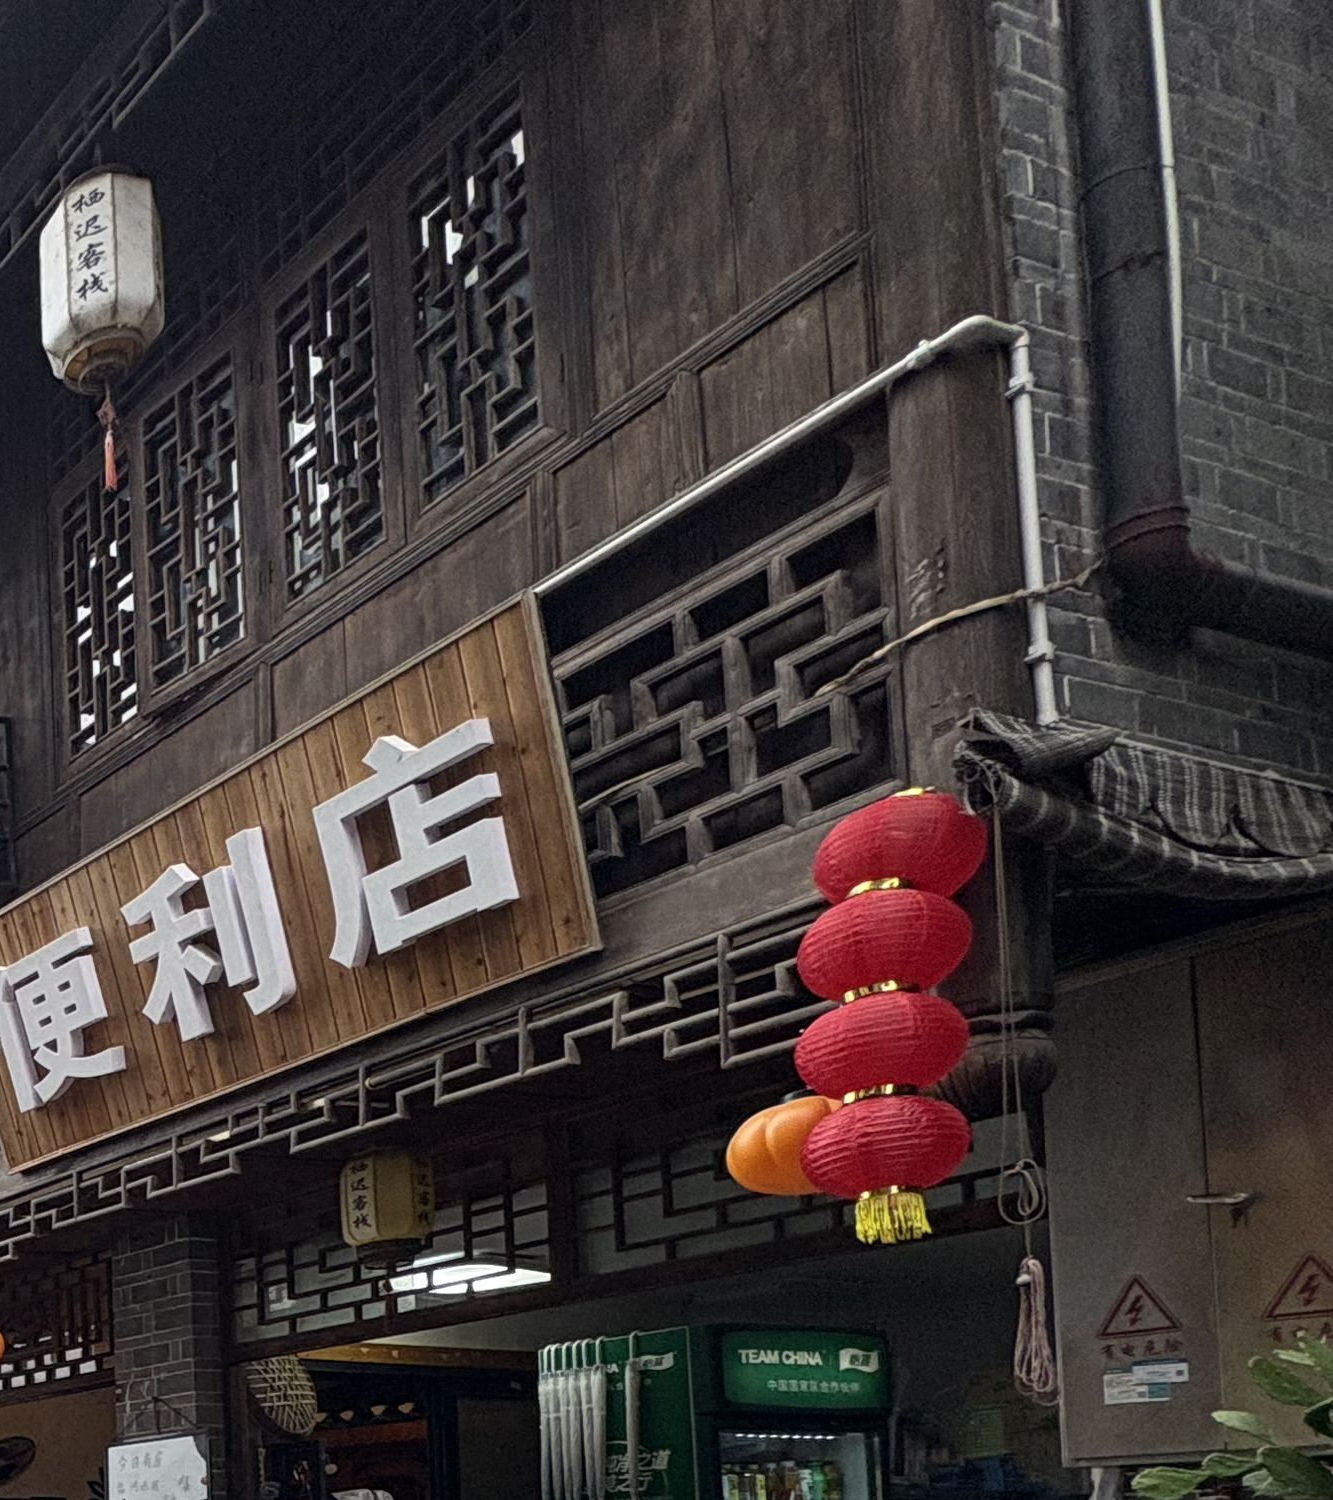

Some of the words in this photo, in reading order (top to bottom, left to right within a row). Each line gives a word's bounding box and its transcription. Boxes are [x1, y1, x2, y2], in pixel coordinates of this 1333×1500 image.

[738, 1349, 780, 1364] TEAM
[782, 1350, 824, 1366] CHINA
[1100, 1337, 1184, 1359] 有电危险
